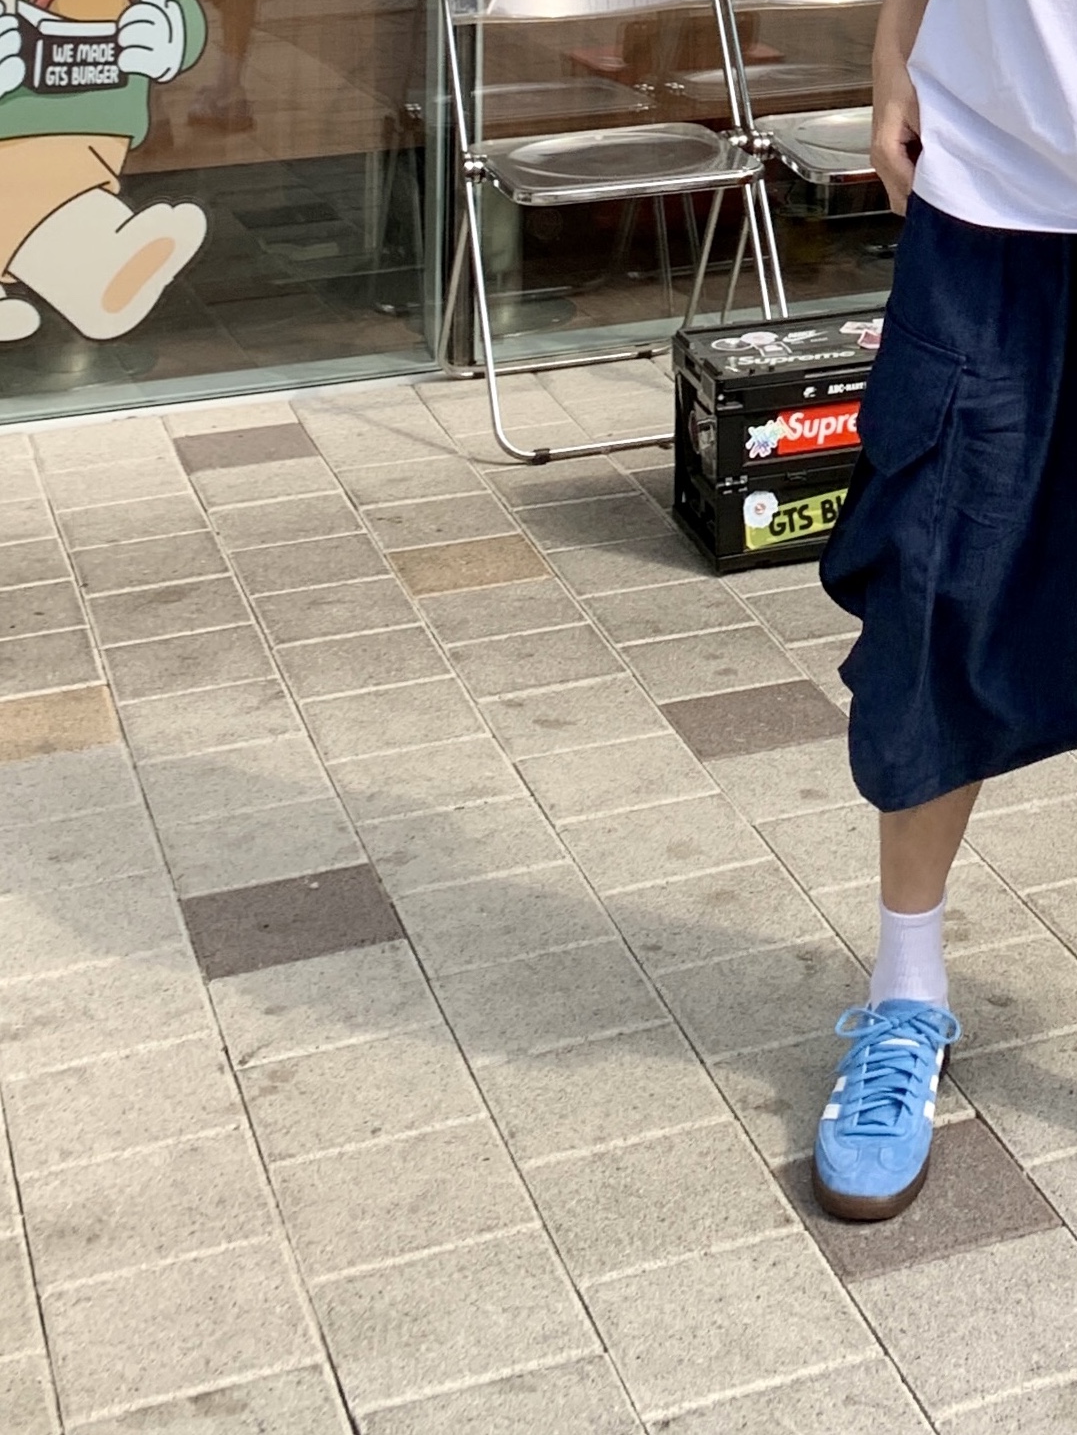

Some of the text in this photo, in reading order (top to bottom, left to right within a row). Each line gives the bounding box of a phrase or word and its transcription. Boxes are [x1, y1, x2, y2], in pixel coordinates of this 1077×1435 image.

[52, 43, 115, 63] WE MADE
[45, 65, 119, 86] GTS BURGER
[738, 350, 856, 366] Supreme
[768, 503, 814, 537] GTS
